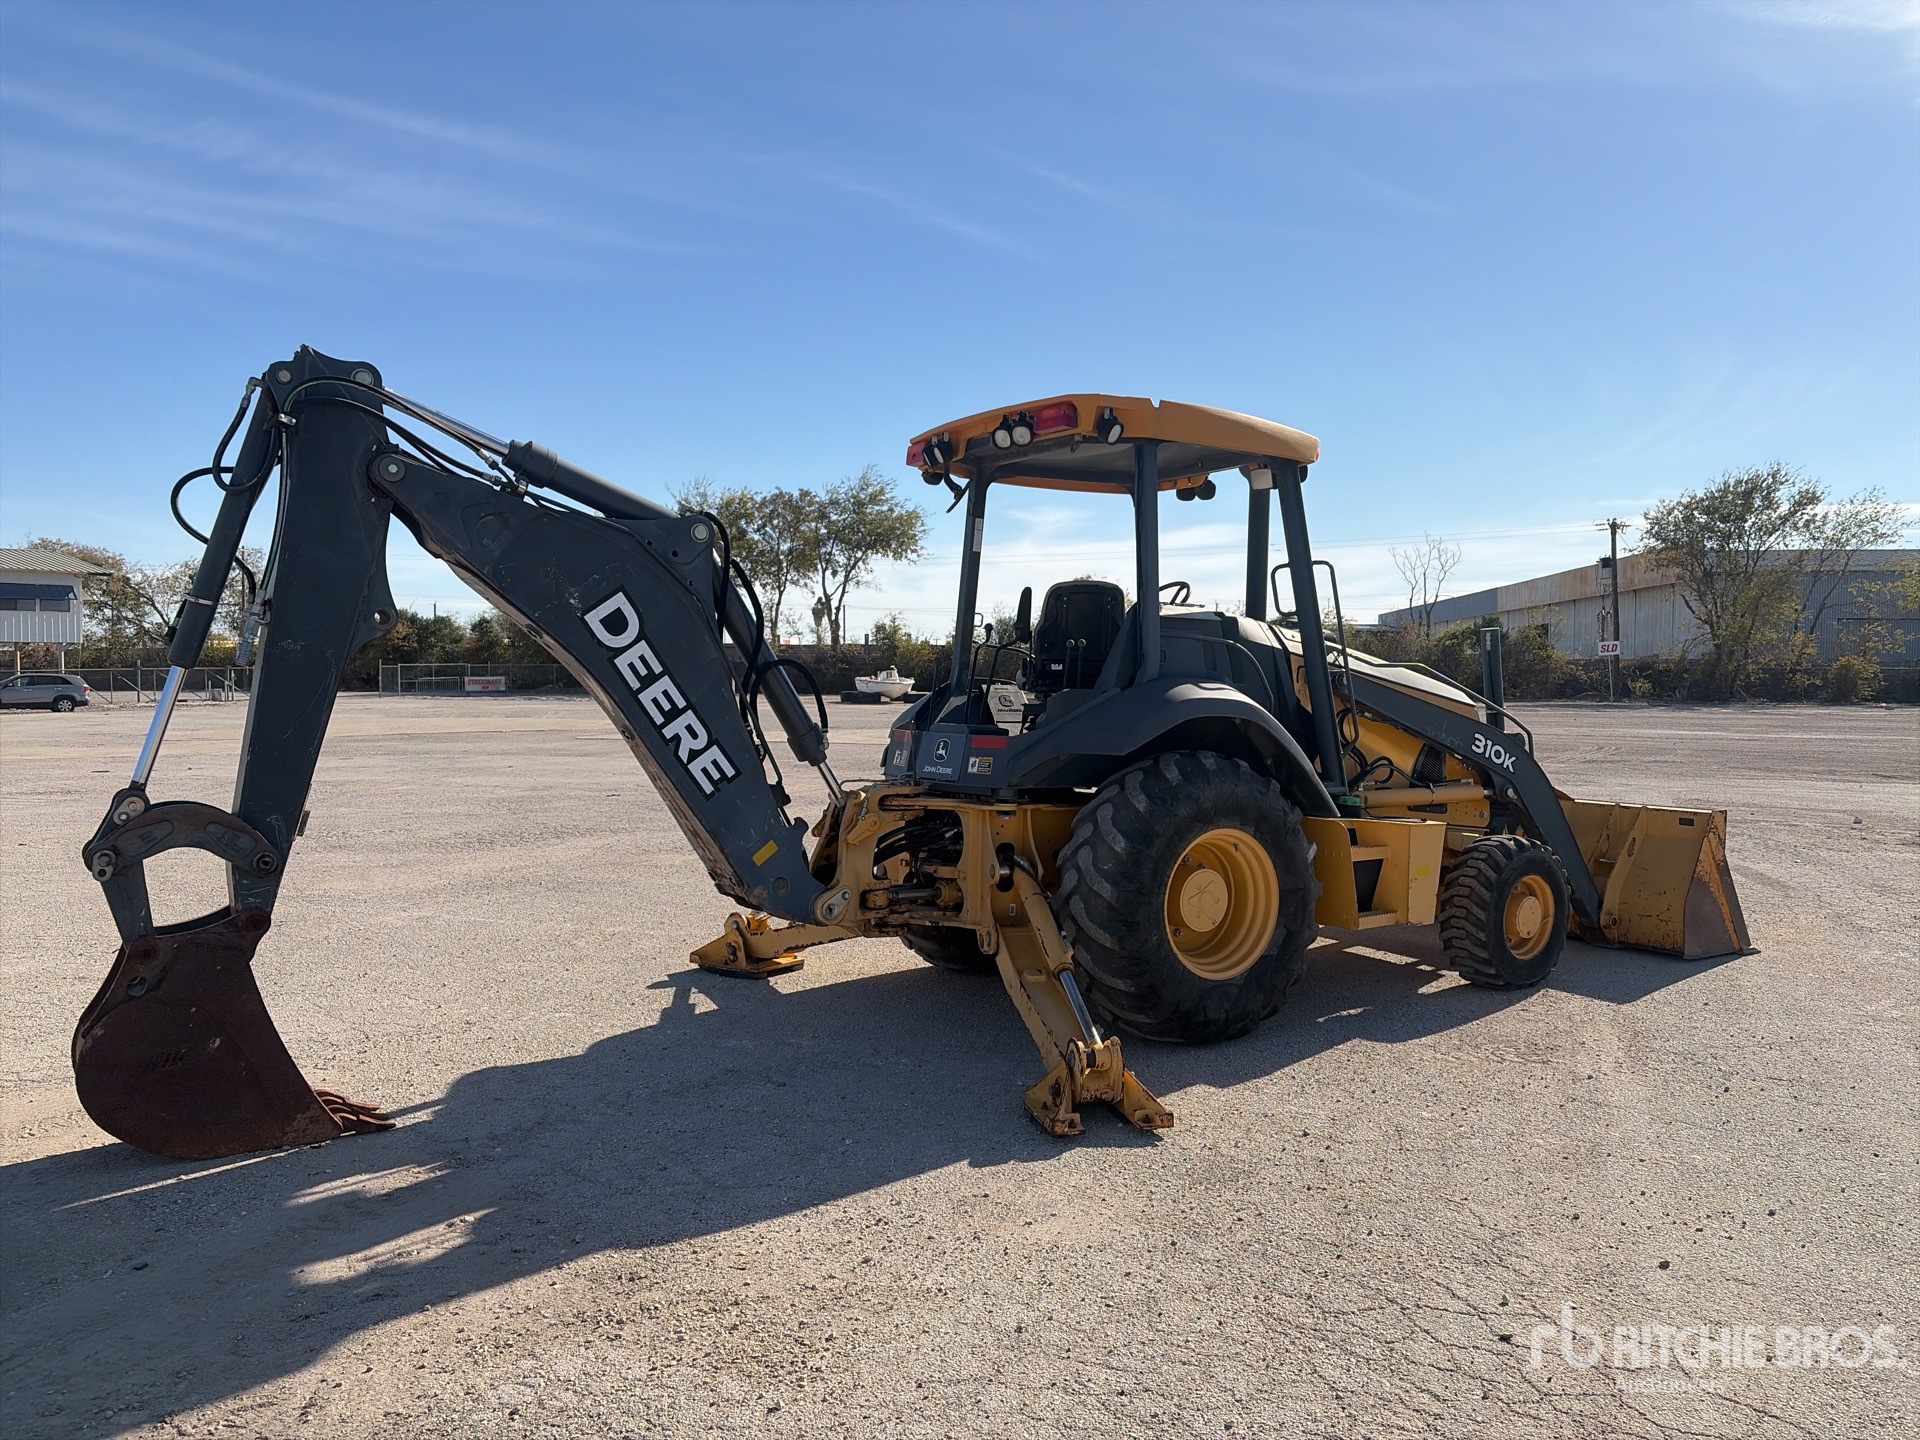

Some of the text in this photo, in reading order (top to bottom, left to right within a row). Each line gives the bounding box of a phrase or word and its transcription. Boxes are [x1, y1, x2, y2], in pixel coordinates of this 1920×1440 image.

[1600, 643, 1618, 653] SLD
[584, 591, 736, 795] DEERE
[1471, 733, 1517, 773] 310K
[922, 765, 953, 775] JOHN DEERE
